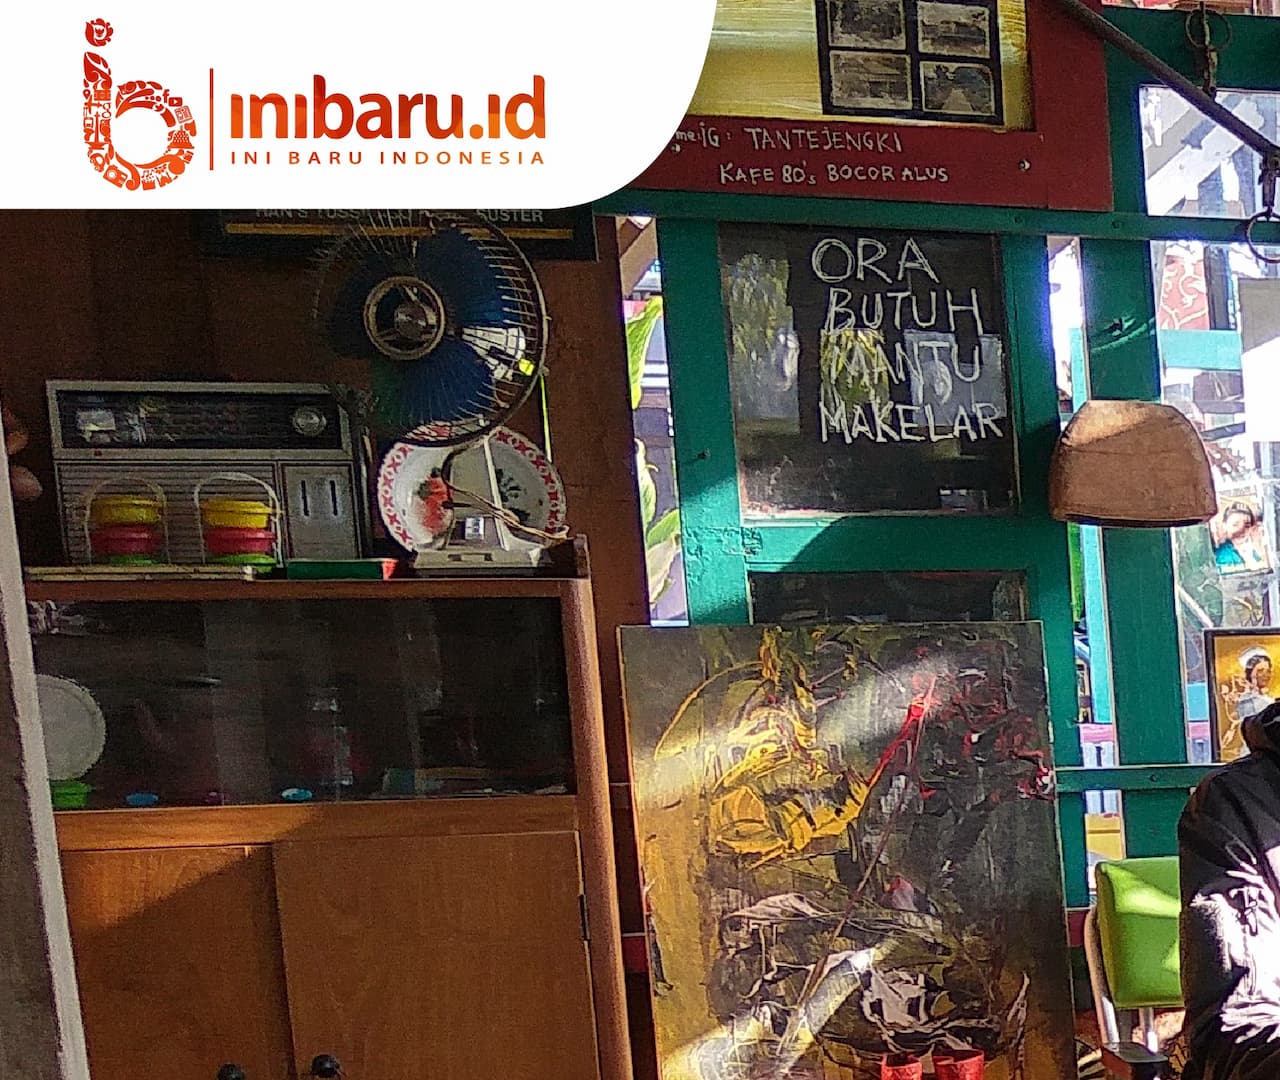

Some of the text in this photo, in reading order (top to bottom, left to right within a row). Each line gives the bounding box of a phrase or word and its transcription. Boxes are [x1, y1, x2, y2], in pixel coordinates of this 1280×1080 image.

[719, 163, 774, 185] KAFE
[827, 163, 896, 183] BOCOR
[901, 166, 949, 183] ALUS
[811, 236, 941, 284] ORA
[822, 286, 985, 336] BUTUH
[818, 398, 1004, 444] MAKELAR
